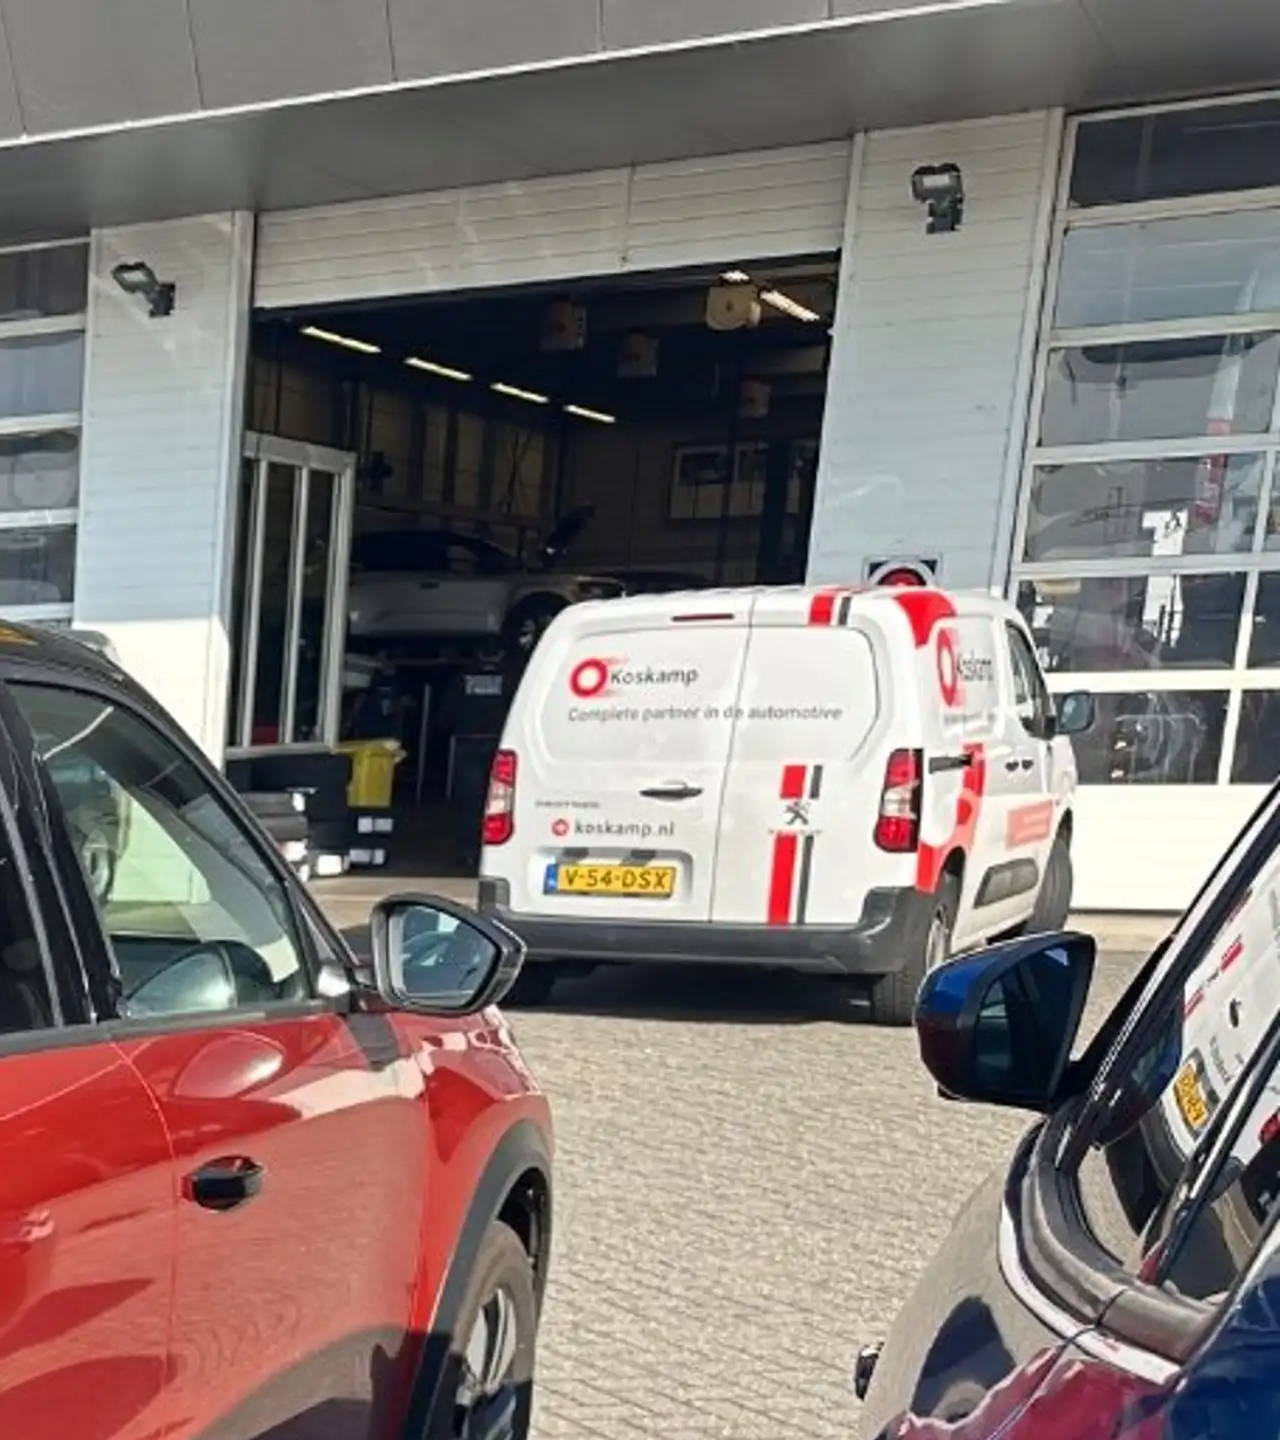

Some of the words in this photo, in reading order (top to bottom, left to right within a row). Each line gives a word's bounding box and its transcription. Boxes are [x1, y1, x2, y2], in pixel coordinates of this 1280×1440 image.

[610, 666, 699, 686] Koskamp
[569, 708, 639, 722] Complete
[641, 707, 699, 722] partner
[704, 706, 721, 720] in
[746, 705, 843, 720] automotive
[574, 820, 675, 838] koskamp.nl
[564, 868, 670, 890] V-54-DSX
